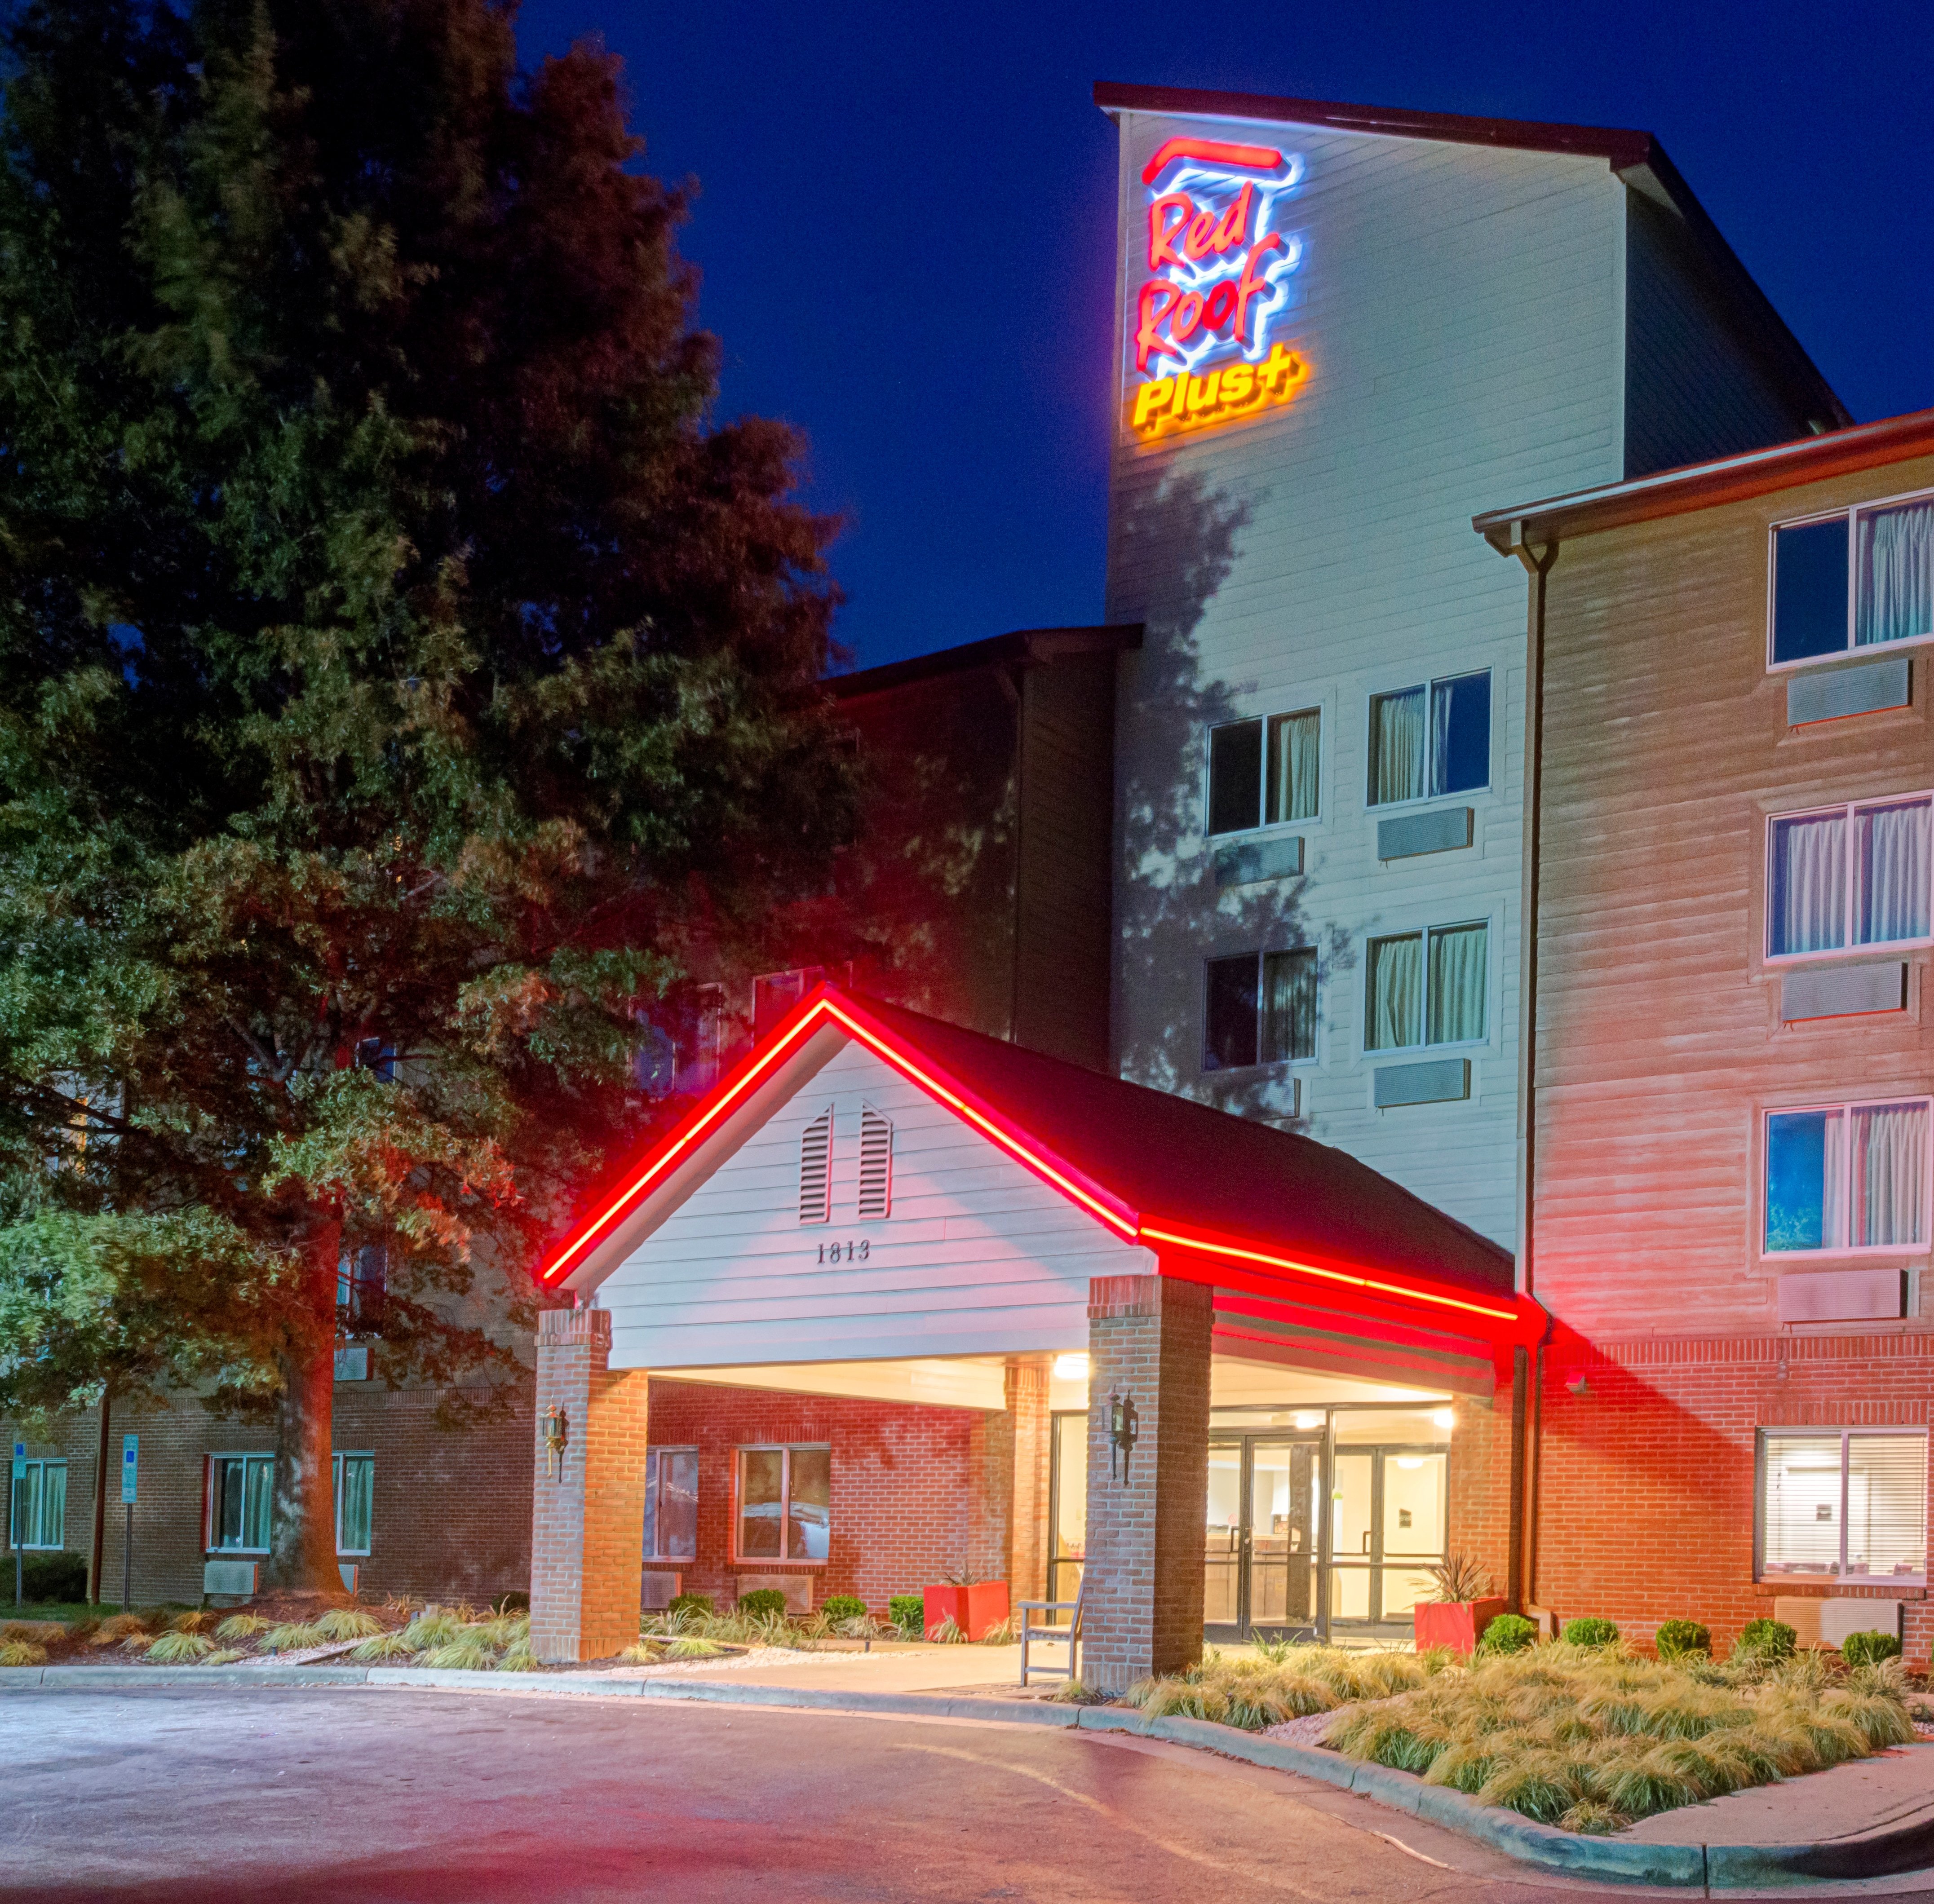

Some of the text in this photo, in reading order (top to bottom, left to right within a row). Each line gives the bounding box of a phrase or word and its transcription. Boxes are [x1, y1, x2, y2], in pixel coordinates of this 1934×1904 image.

[1149, 181, 1253, 272] Red
[1136, 233, 1279, 371] Roof
[817, 1239, 870, 1264] 1813
